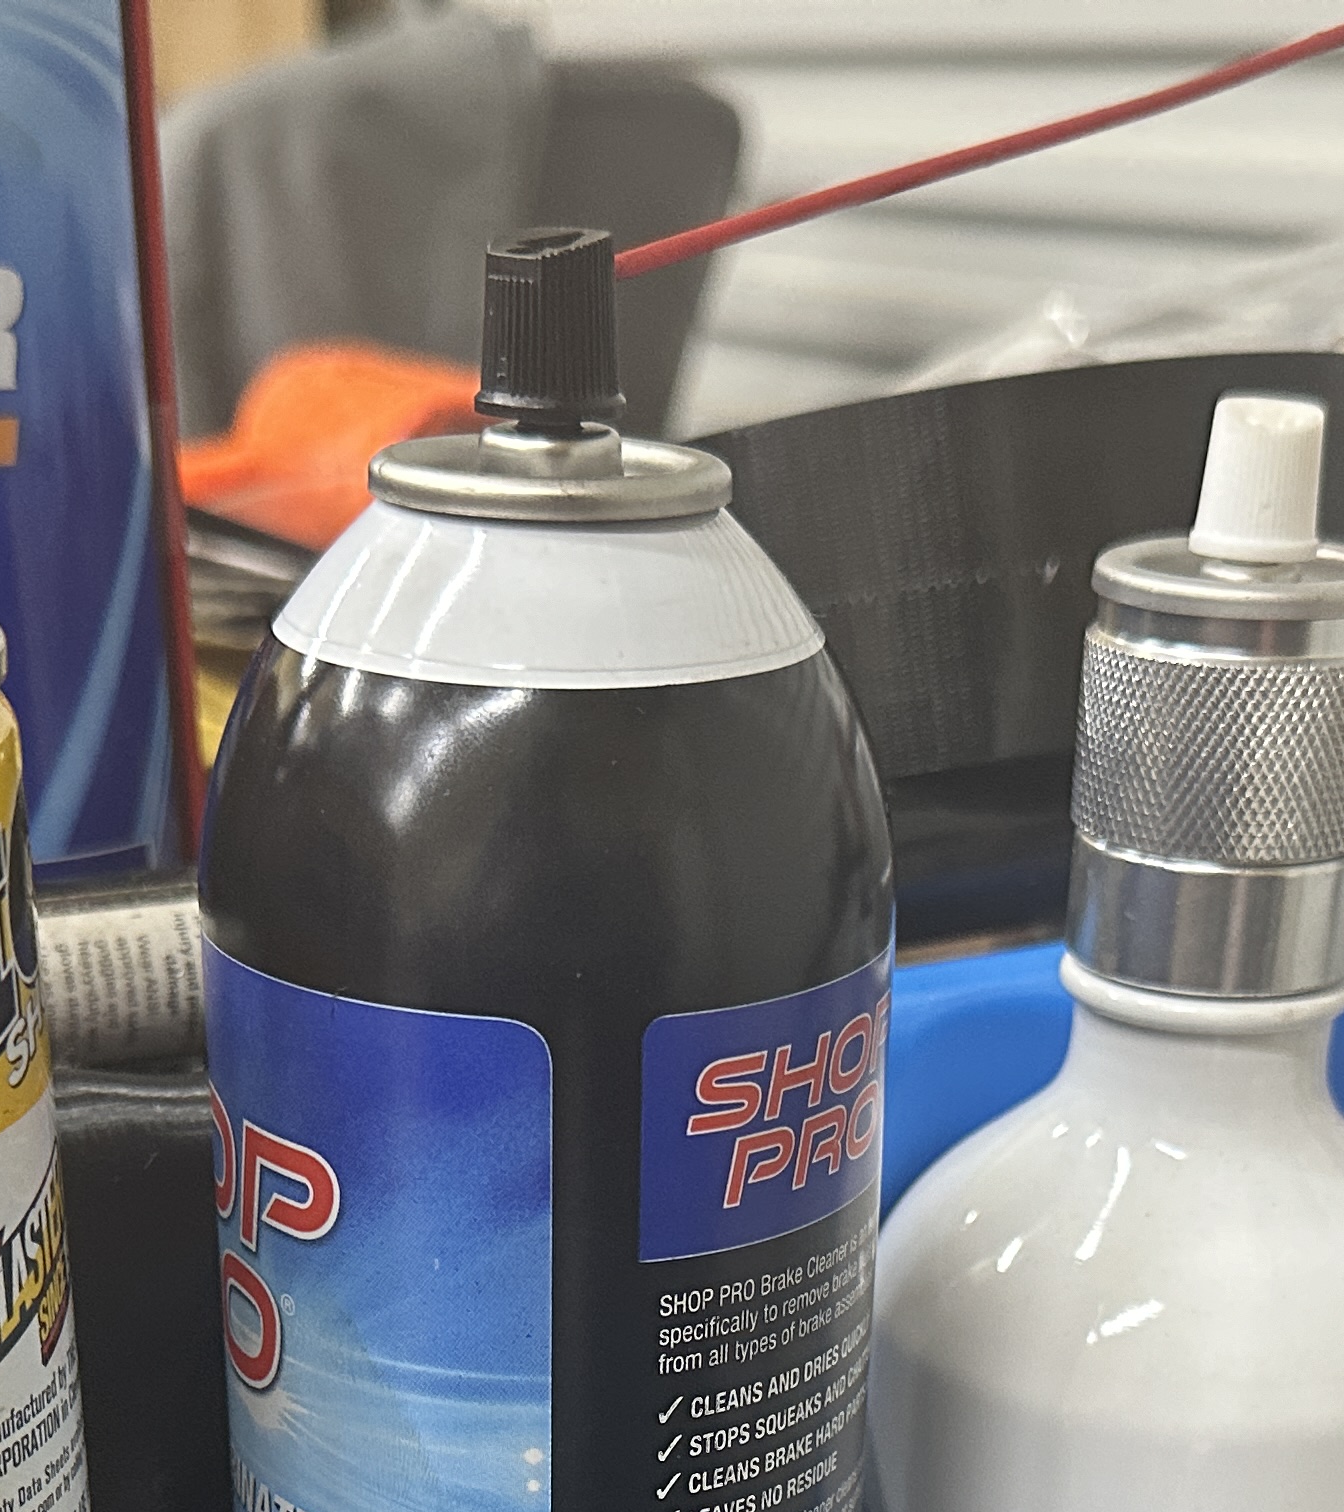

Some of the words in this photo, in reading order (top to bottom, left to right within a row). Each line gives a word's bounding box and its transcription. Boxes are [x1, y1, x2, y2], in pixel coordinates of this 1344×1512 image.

[722, 1080, 881, 1210] PRO
[658, 1308, 759, 1349] specifically
[763, 1303, 778, 1325] to
[782, 1280, 830, 1318] remove
[659, 1287, 715, 1318] SHOP
[719, 1277, 756, 1308] PRO
[760, 1265, 804, 1297] Brake
[658, 1350, 703, 1376] from
[708, 1342, 729, 1367] all
[735, 1332, 778, 1364] types
[780, 1321, 796, 1346] of
[690, 1380, 764, 1420] CLEANS
[767, 1366, 800, 1400] AND
[803, 1343, 840, 1384] DRIES
[688, 1422, 751, 1458] STOPS
[753, 1391, 822, 1440] SQUEAKS
[17, 1477, 44, 1507] Data
[687, 1456, 761, 1495] CLEANS
[764, 1431, 813, 1473] BRAKE
[760, 1484, 783, 1511] NO
[786, 1450, 838, 1500] RESIDUE
